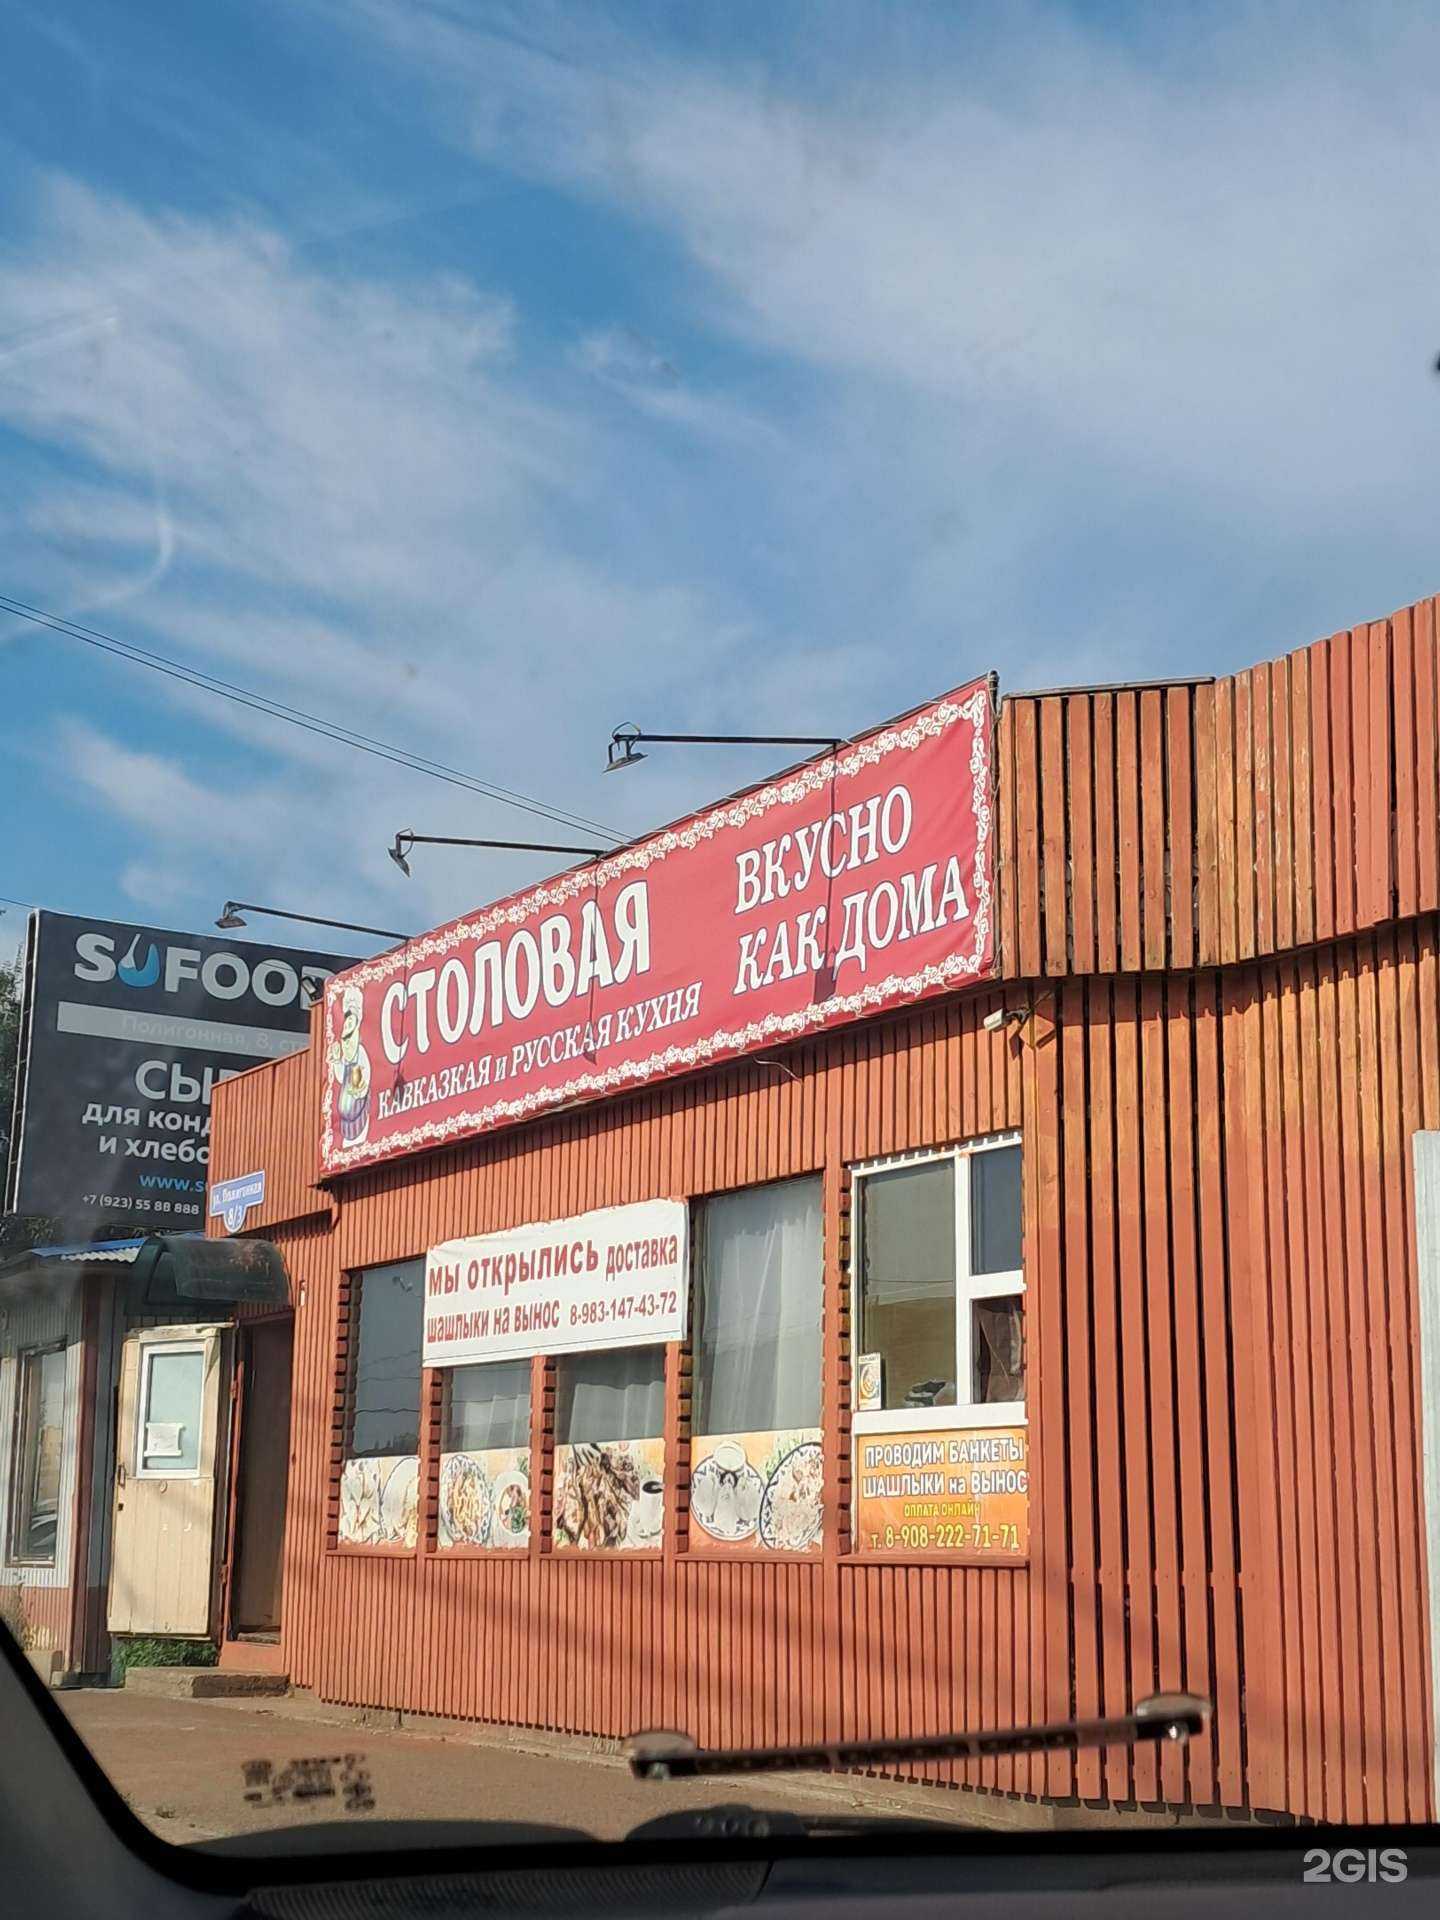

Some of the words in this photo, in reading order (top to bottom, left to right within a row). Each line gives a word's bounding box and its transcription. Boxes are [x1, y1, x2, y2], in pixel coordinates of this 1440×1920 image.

[735, 785, 913, 914] ВКУСНО
[732, 905, 827, 995] КАК
[831, 855, 970, 981] ДОМА
[379, 880, 650, 1064] СТОЛОВАЯ
[376, 1054, 493, 1121] КАВКАЗКАЯ
[510, 1017, 613, 1077] РУССКАЯ
[615, 982, 703, 1041] КУХНЯ
[135, 1060, 242, 1105] СЫ
[82, 1103, 140, 1126] для
[99, 1135, 117, 1155] и
[125, 1137, 209, 1165] хлебо
[139, 1175, 208, 1193] www.s
[82, 1194, 97, 1206] +7
[99, 1195, 133, 1210] (923)
[135, 1198, 151, 1211] 55
[154, 1200, 171, 1212] 88
[174, 1202, 200, 1215] 888
[428, 1264, 460, 1297] мы
[467, 1239, 599, 1296] открылись
[605, 1234, 678, 1281] доставка
[427, 1309, 489, 1344] шашлыки
[493, 1307, 510, 1336] на
[514, 1300, 560, 1333] вынос
[569, 1290, 677, 1327] 8-983-147-43-72
[865, 1441, 944, 1469] ПРОВОДИМ
[949, 1437, 1024, 1464] БАНКЕТЫ
[862, 1472, 944, 1498] ШАШЛЫКИ
[949, 1477, 965, 1495] на
[970, 1470, 1029, 1495] ВЫНОС
[904, 1502, 939, 1518] ОПЛАТА
[941, 1499, 980, 1517] ОНЛАЙН
[884, 1522, 1020, 1550] 8-908-222-71-71
